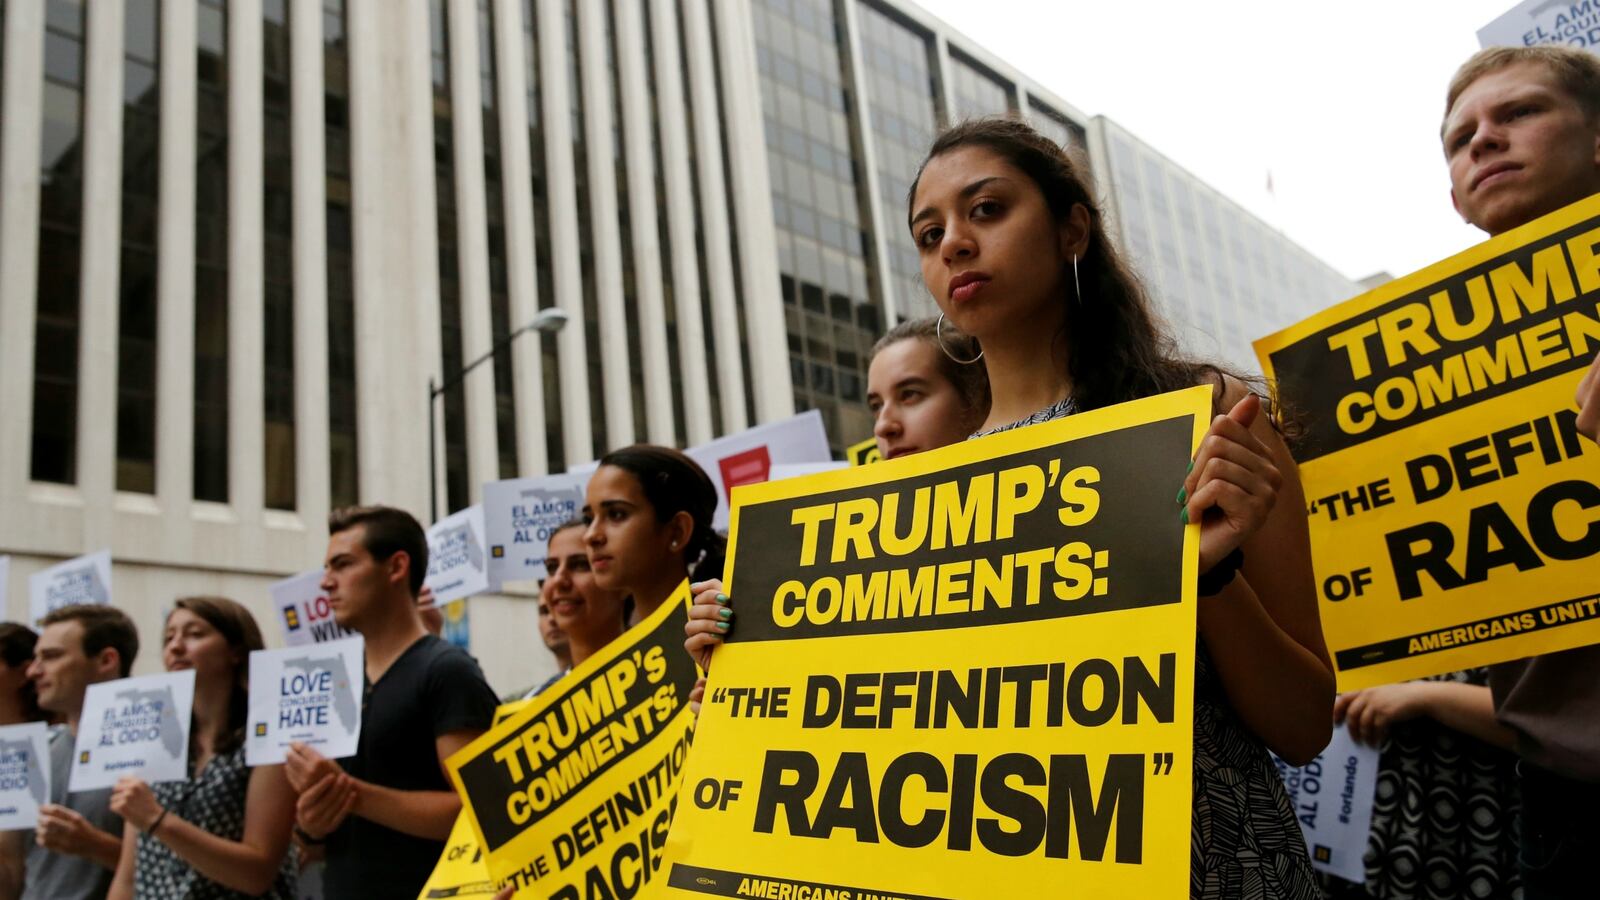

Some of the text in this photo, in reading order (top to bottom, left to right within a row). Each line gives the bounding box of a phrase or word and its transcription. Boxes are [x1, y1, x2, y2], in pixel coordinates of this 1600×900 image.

[512, 500, 575, 518] EL AMOR
[514, 530, 533, 543] AL
[790, 458, 1101, 567] TRUMP'S
[1384, 480, 1600, 602] RAC
[771, 541, 1109, 628] COMMENTS:
[1323, 566, 1373, 602] OF
[1408, 598, 1600, 654] AMERICANS UNIT
[278, 705, 328, 730] HATE
[281, 671, 332, 696] LOVE
[492, 645, 667, 784] TRUMP'S
[711, 652, 1176, 730] “THE DEFINITION
[505, 683, 678, 826] COMMENTS:
[1339, 756, 1359, 824] #orlando
[694, 749, 1174, 866] OF RACISM”
[1300, 755, 1323, 830] AL OD
